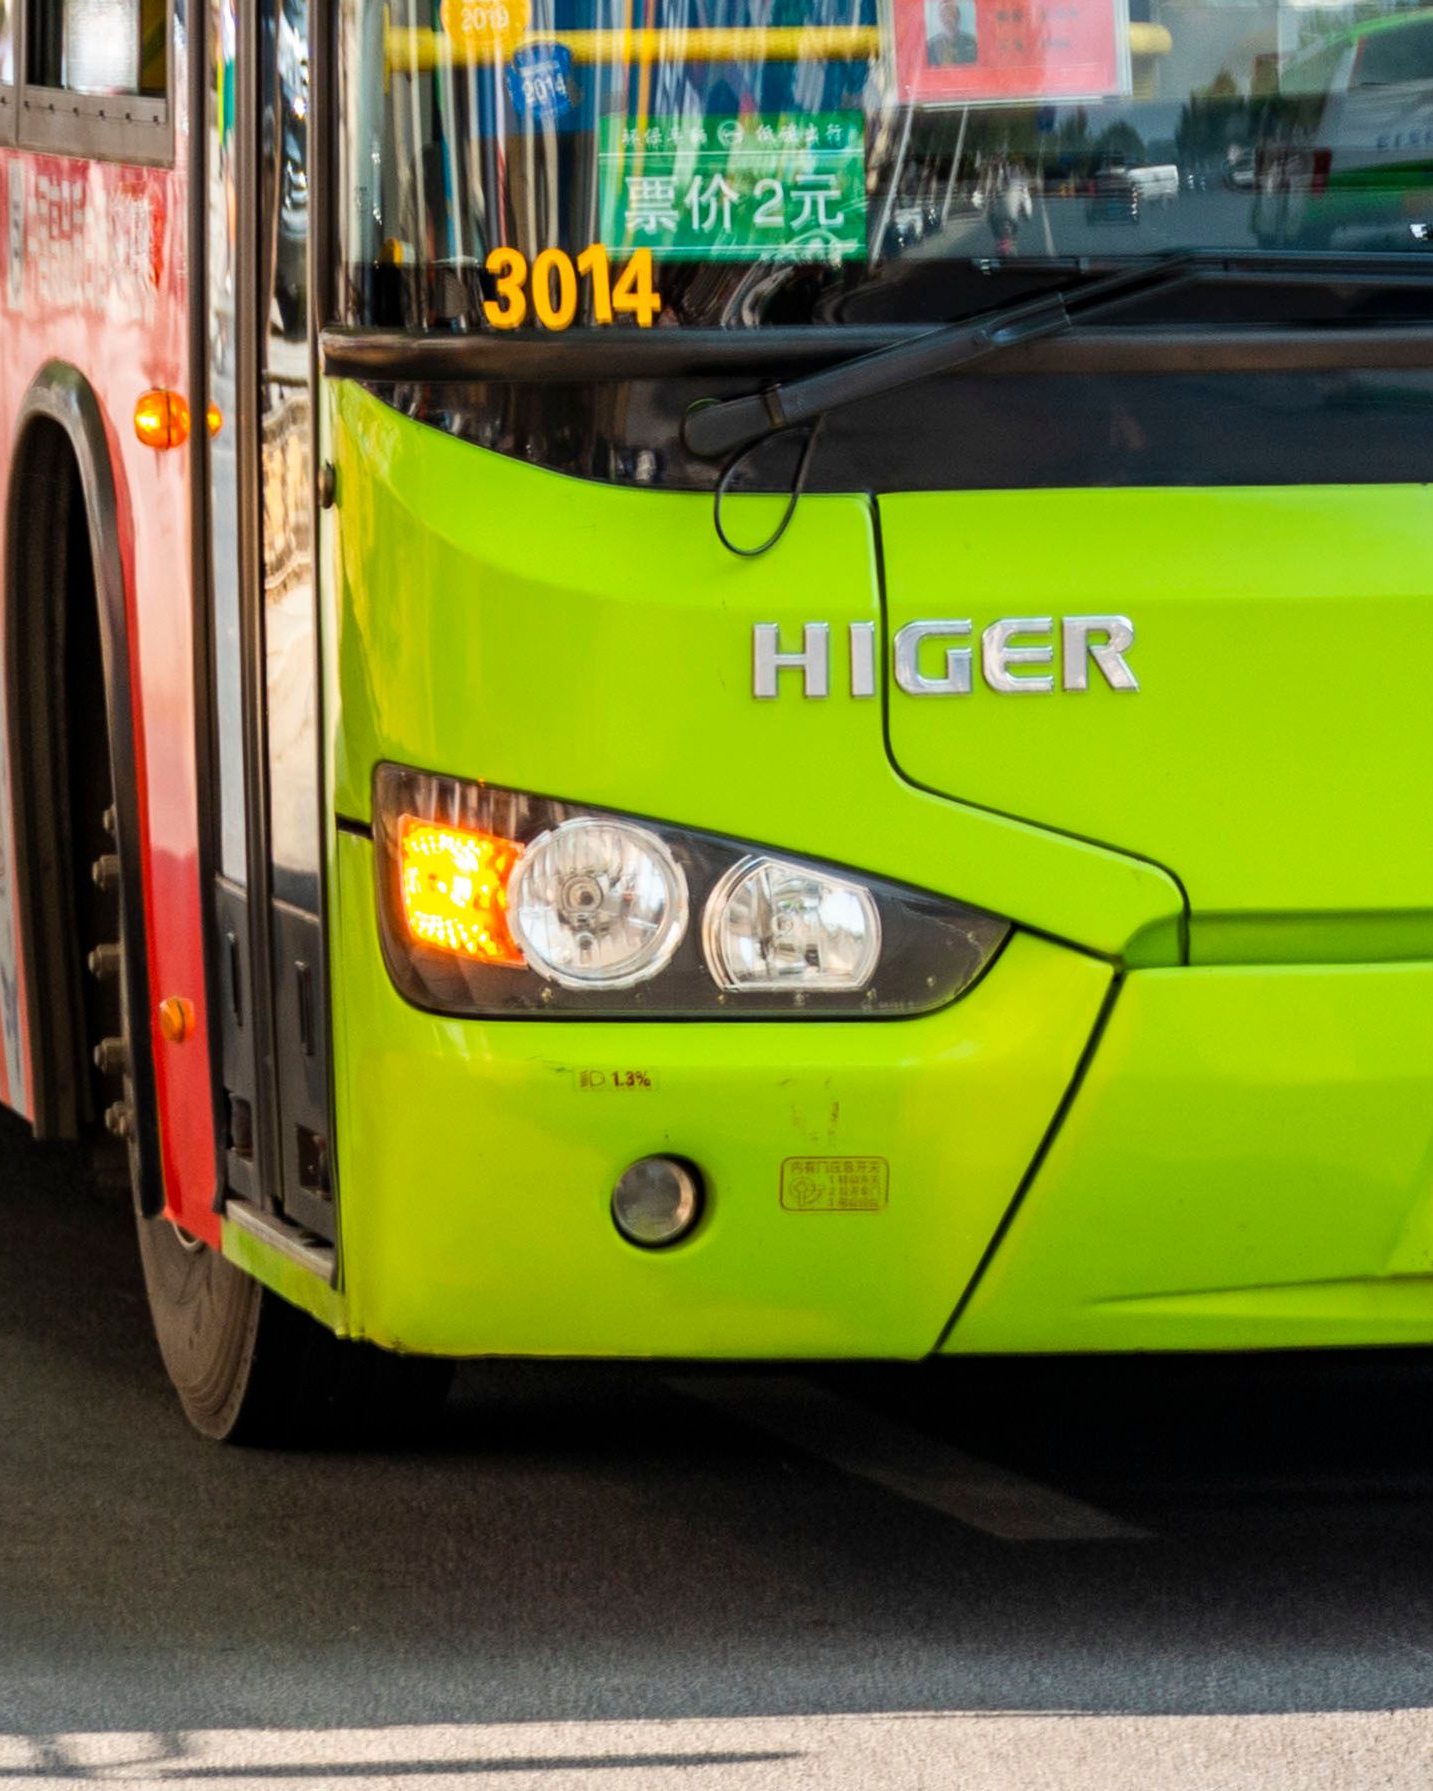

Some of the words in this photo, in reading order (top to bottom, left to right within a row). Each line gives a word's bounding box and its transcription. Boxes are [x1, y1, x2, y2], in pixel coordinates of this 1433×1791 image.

[624, 173, 845, 235] 票价2元
[483, 241, 662, 331] 3014
[752, 615, 1141, 699] HIGER
